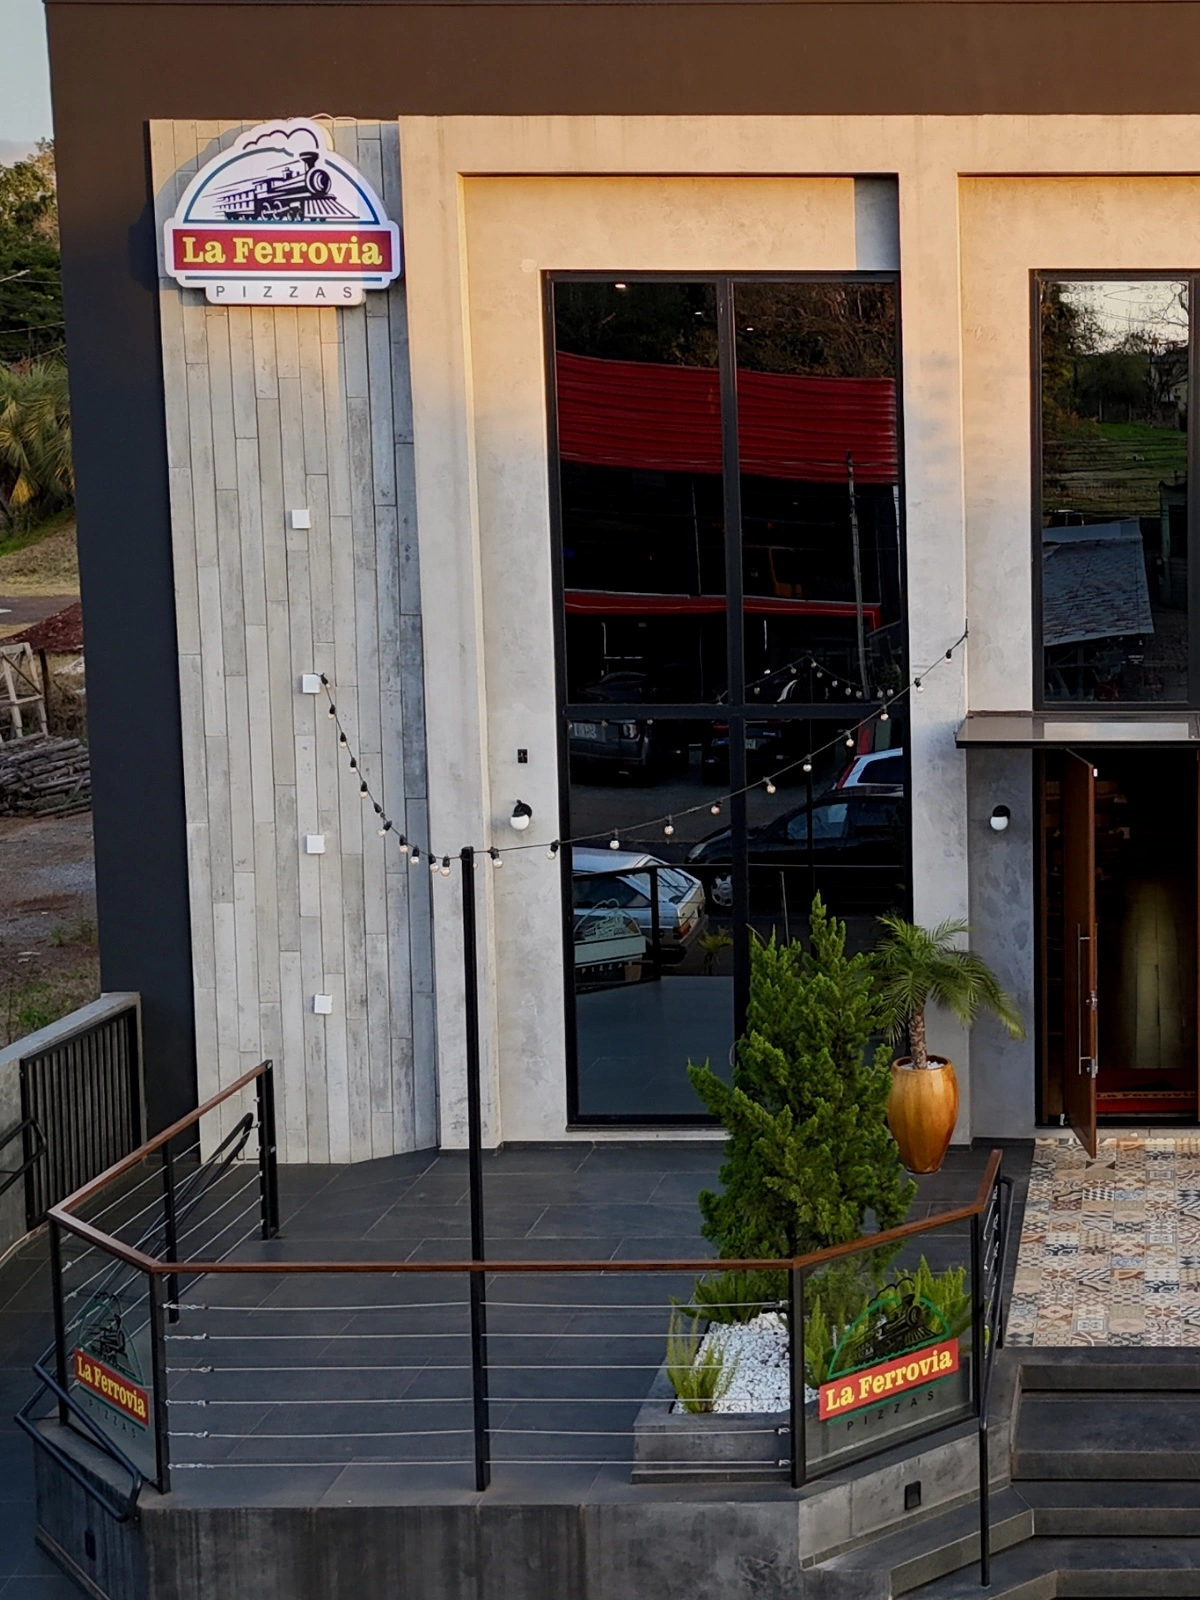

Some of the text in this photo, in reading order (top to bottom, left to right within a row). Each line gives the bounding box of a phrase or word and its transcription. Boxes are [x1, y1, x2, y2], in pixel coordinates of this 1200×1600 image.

[182, 235, 383, 265] La Ferrovia
[216, 285, 353, 298] PIZZAS
[77, 1356, 146, 1418] La Ferrovia
[826, 1350, 953, 1411] La Ferrovia
[847, 1390, 934, 1431] PIZZAS
